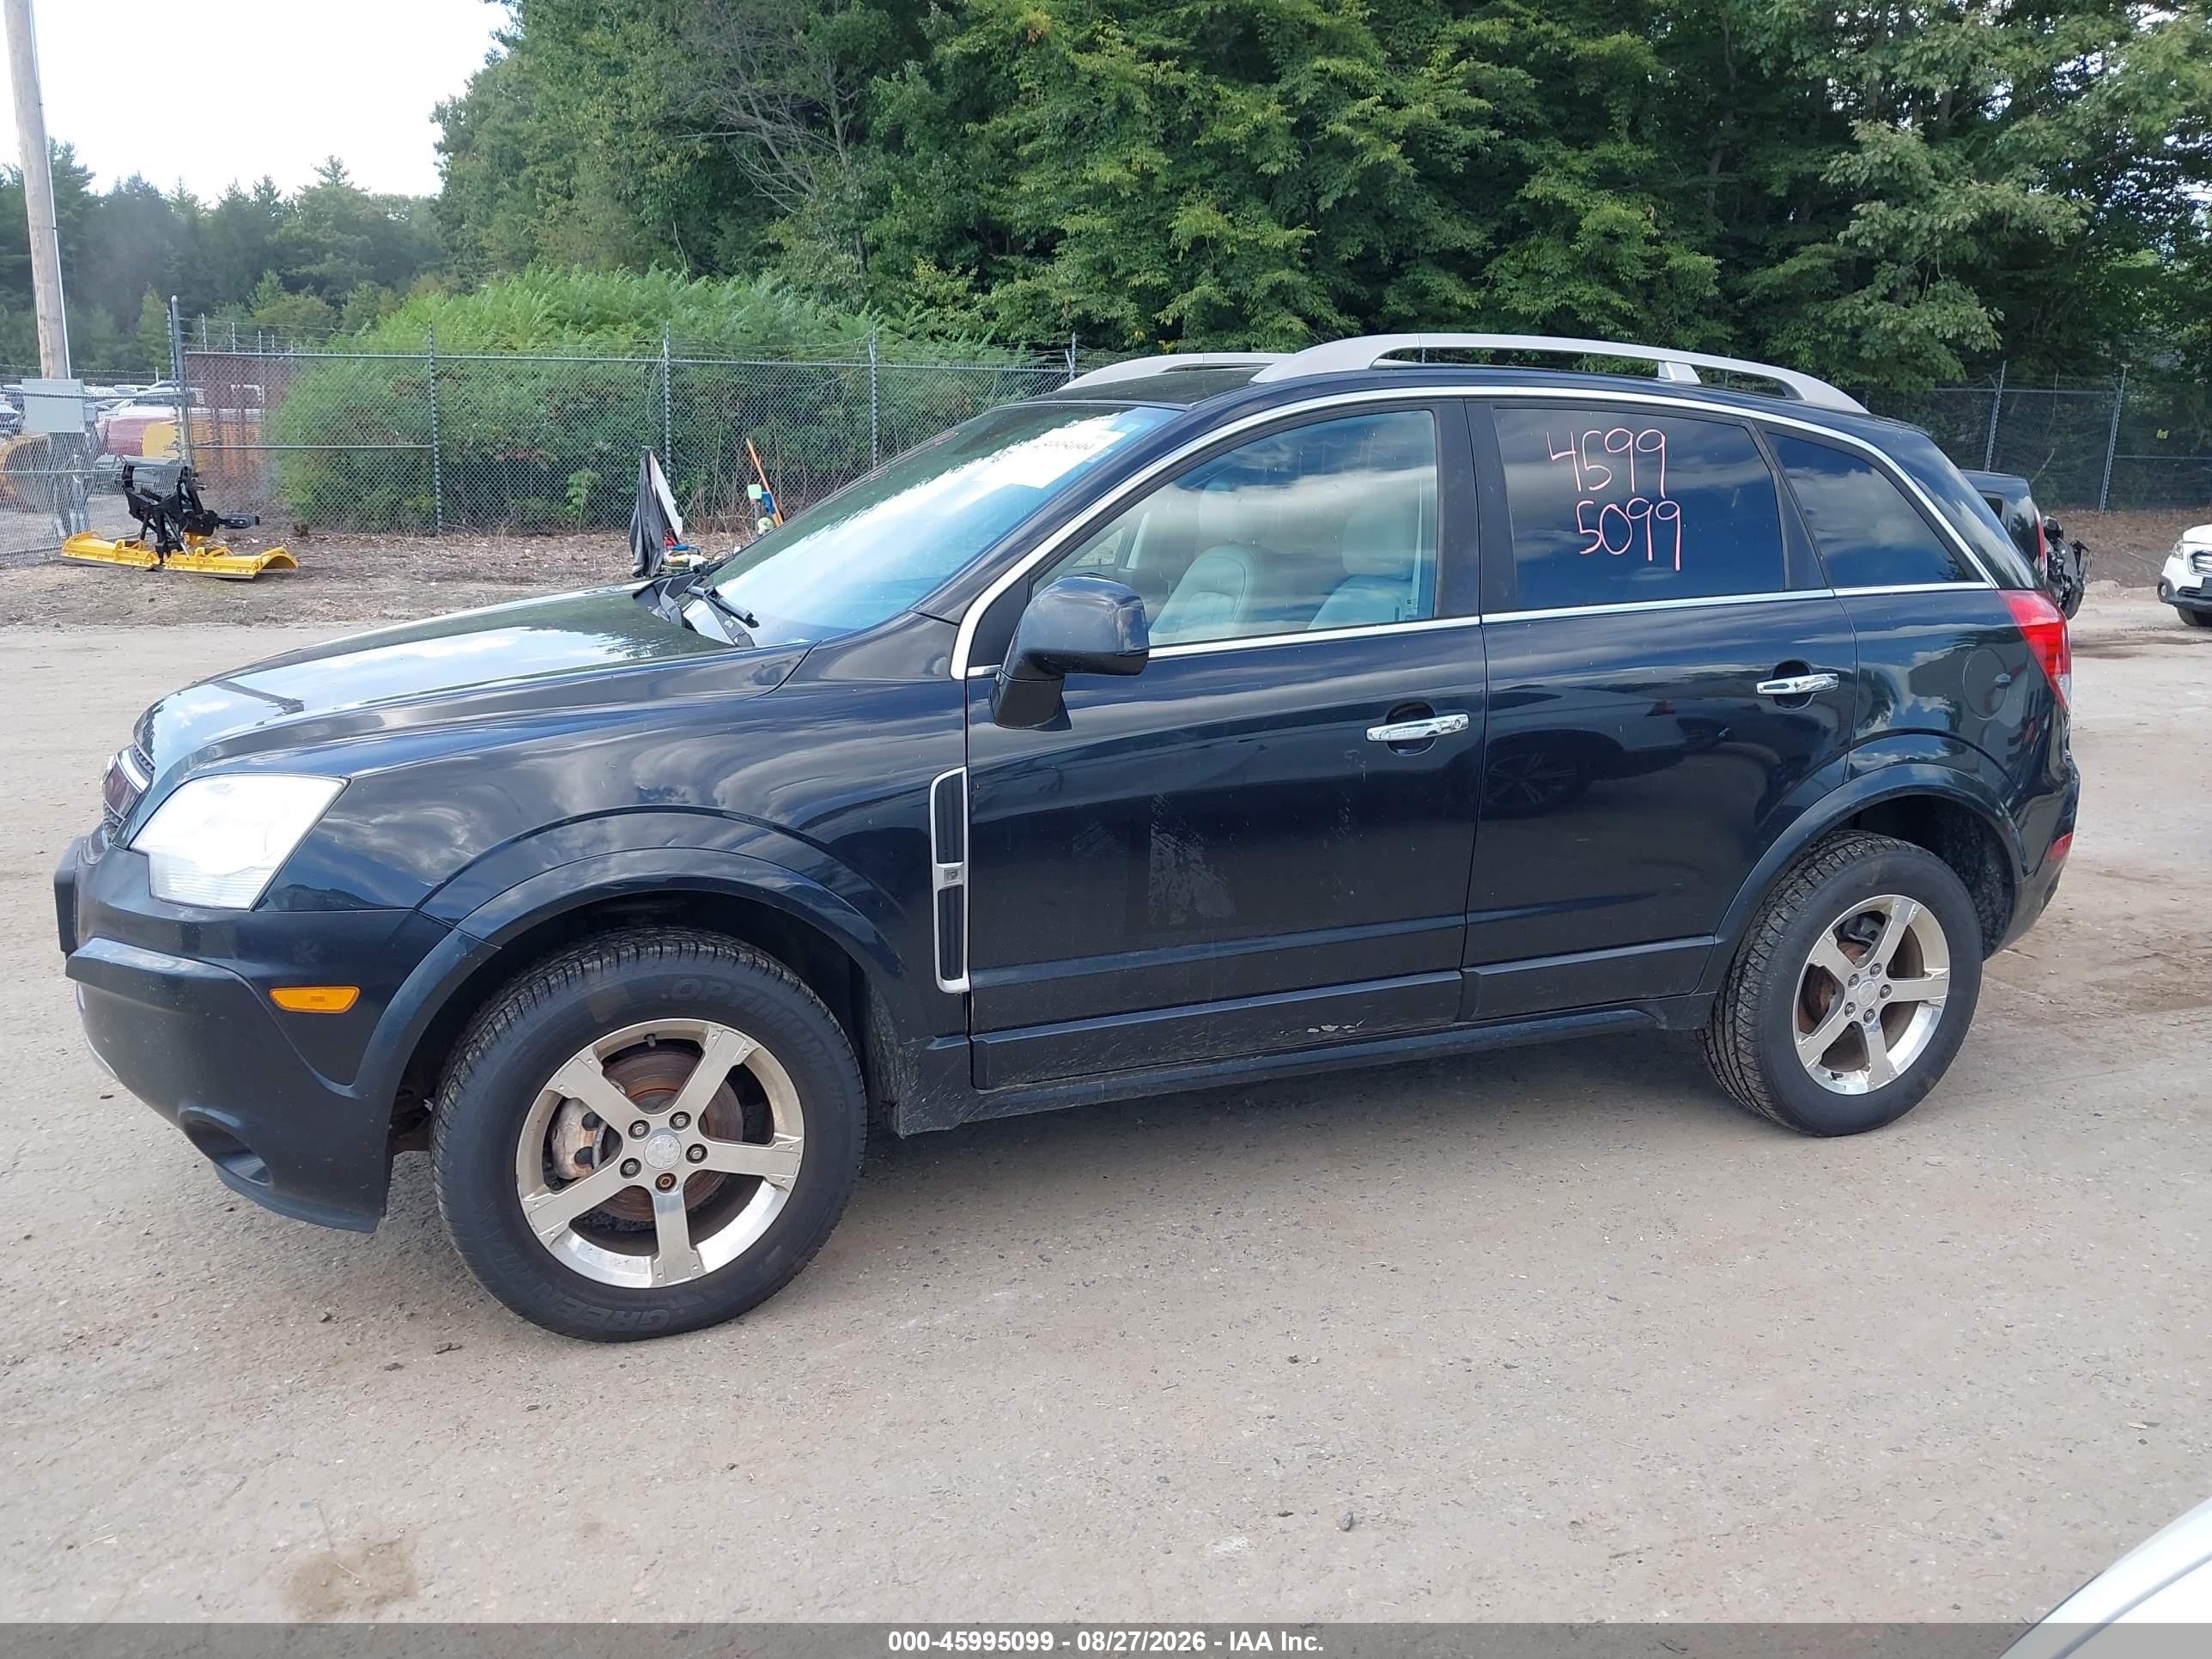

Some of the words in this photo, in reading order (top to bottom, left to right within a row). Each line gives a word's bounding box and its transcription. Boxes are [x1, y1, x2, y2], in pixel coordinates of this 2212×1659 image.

[1546, 427, 1667, 499] 4599
[1576, 496, 1681, 572] 5099
[670, 975, 836, 1072] OPTIMUM
[526, 1281, 671, 1332] GREEN
